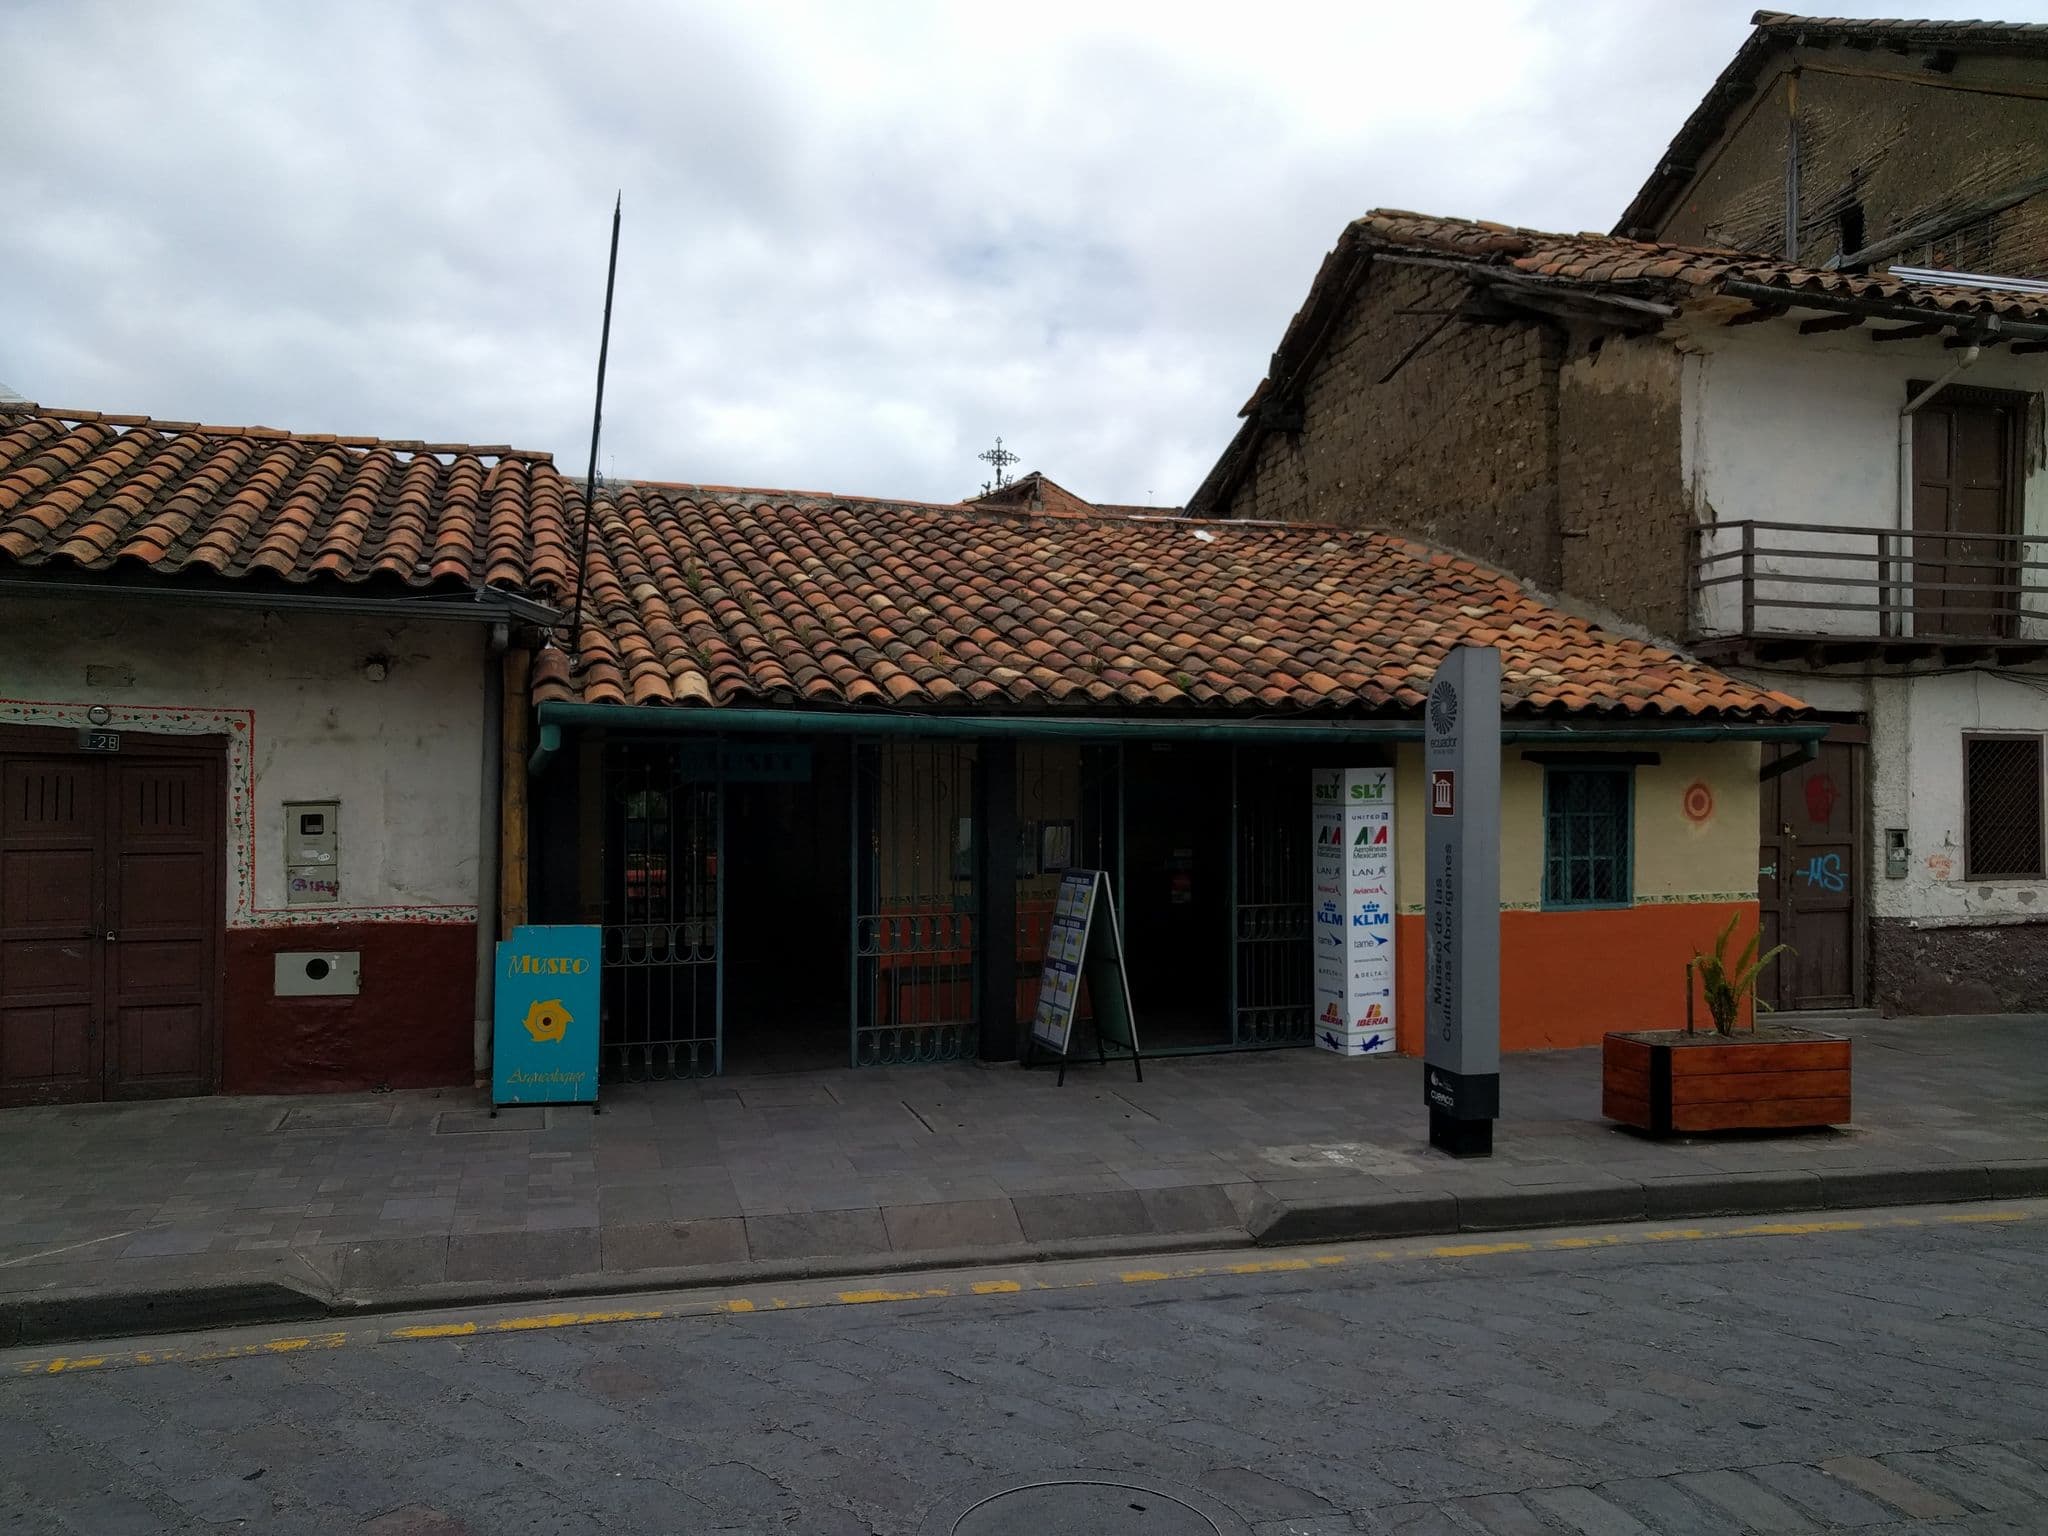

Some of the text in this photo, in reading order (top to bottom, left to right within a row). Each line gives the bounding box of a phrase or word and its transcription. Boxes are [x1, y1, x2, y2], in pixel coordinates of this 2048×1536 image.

[1316, 783, 1340, 799] SLT
[1350, 783, 1386, 799] SLT
[1317, 866, 1332, 875] LAN
[1352, 868, 1374, 876] LAN
[1317, 911, 1343, 926] KLM
[1353, 912, 1390, 926] KLM
[1354, 939, 1375, 948] tame
[1434, 878, 1443, 1005] Museo de las
[508, 955, 590, 977] MUSEO
[1442, 960, 1452, 1042] Culturas
[1357, 1017, 1388, 1027] IBERIA
